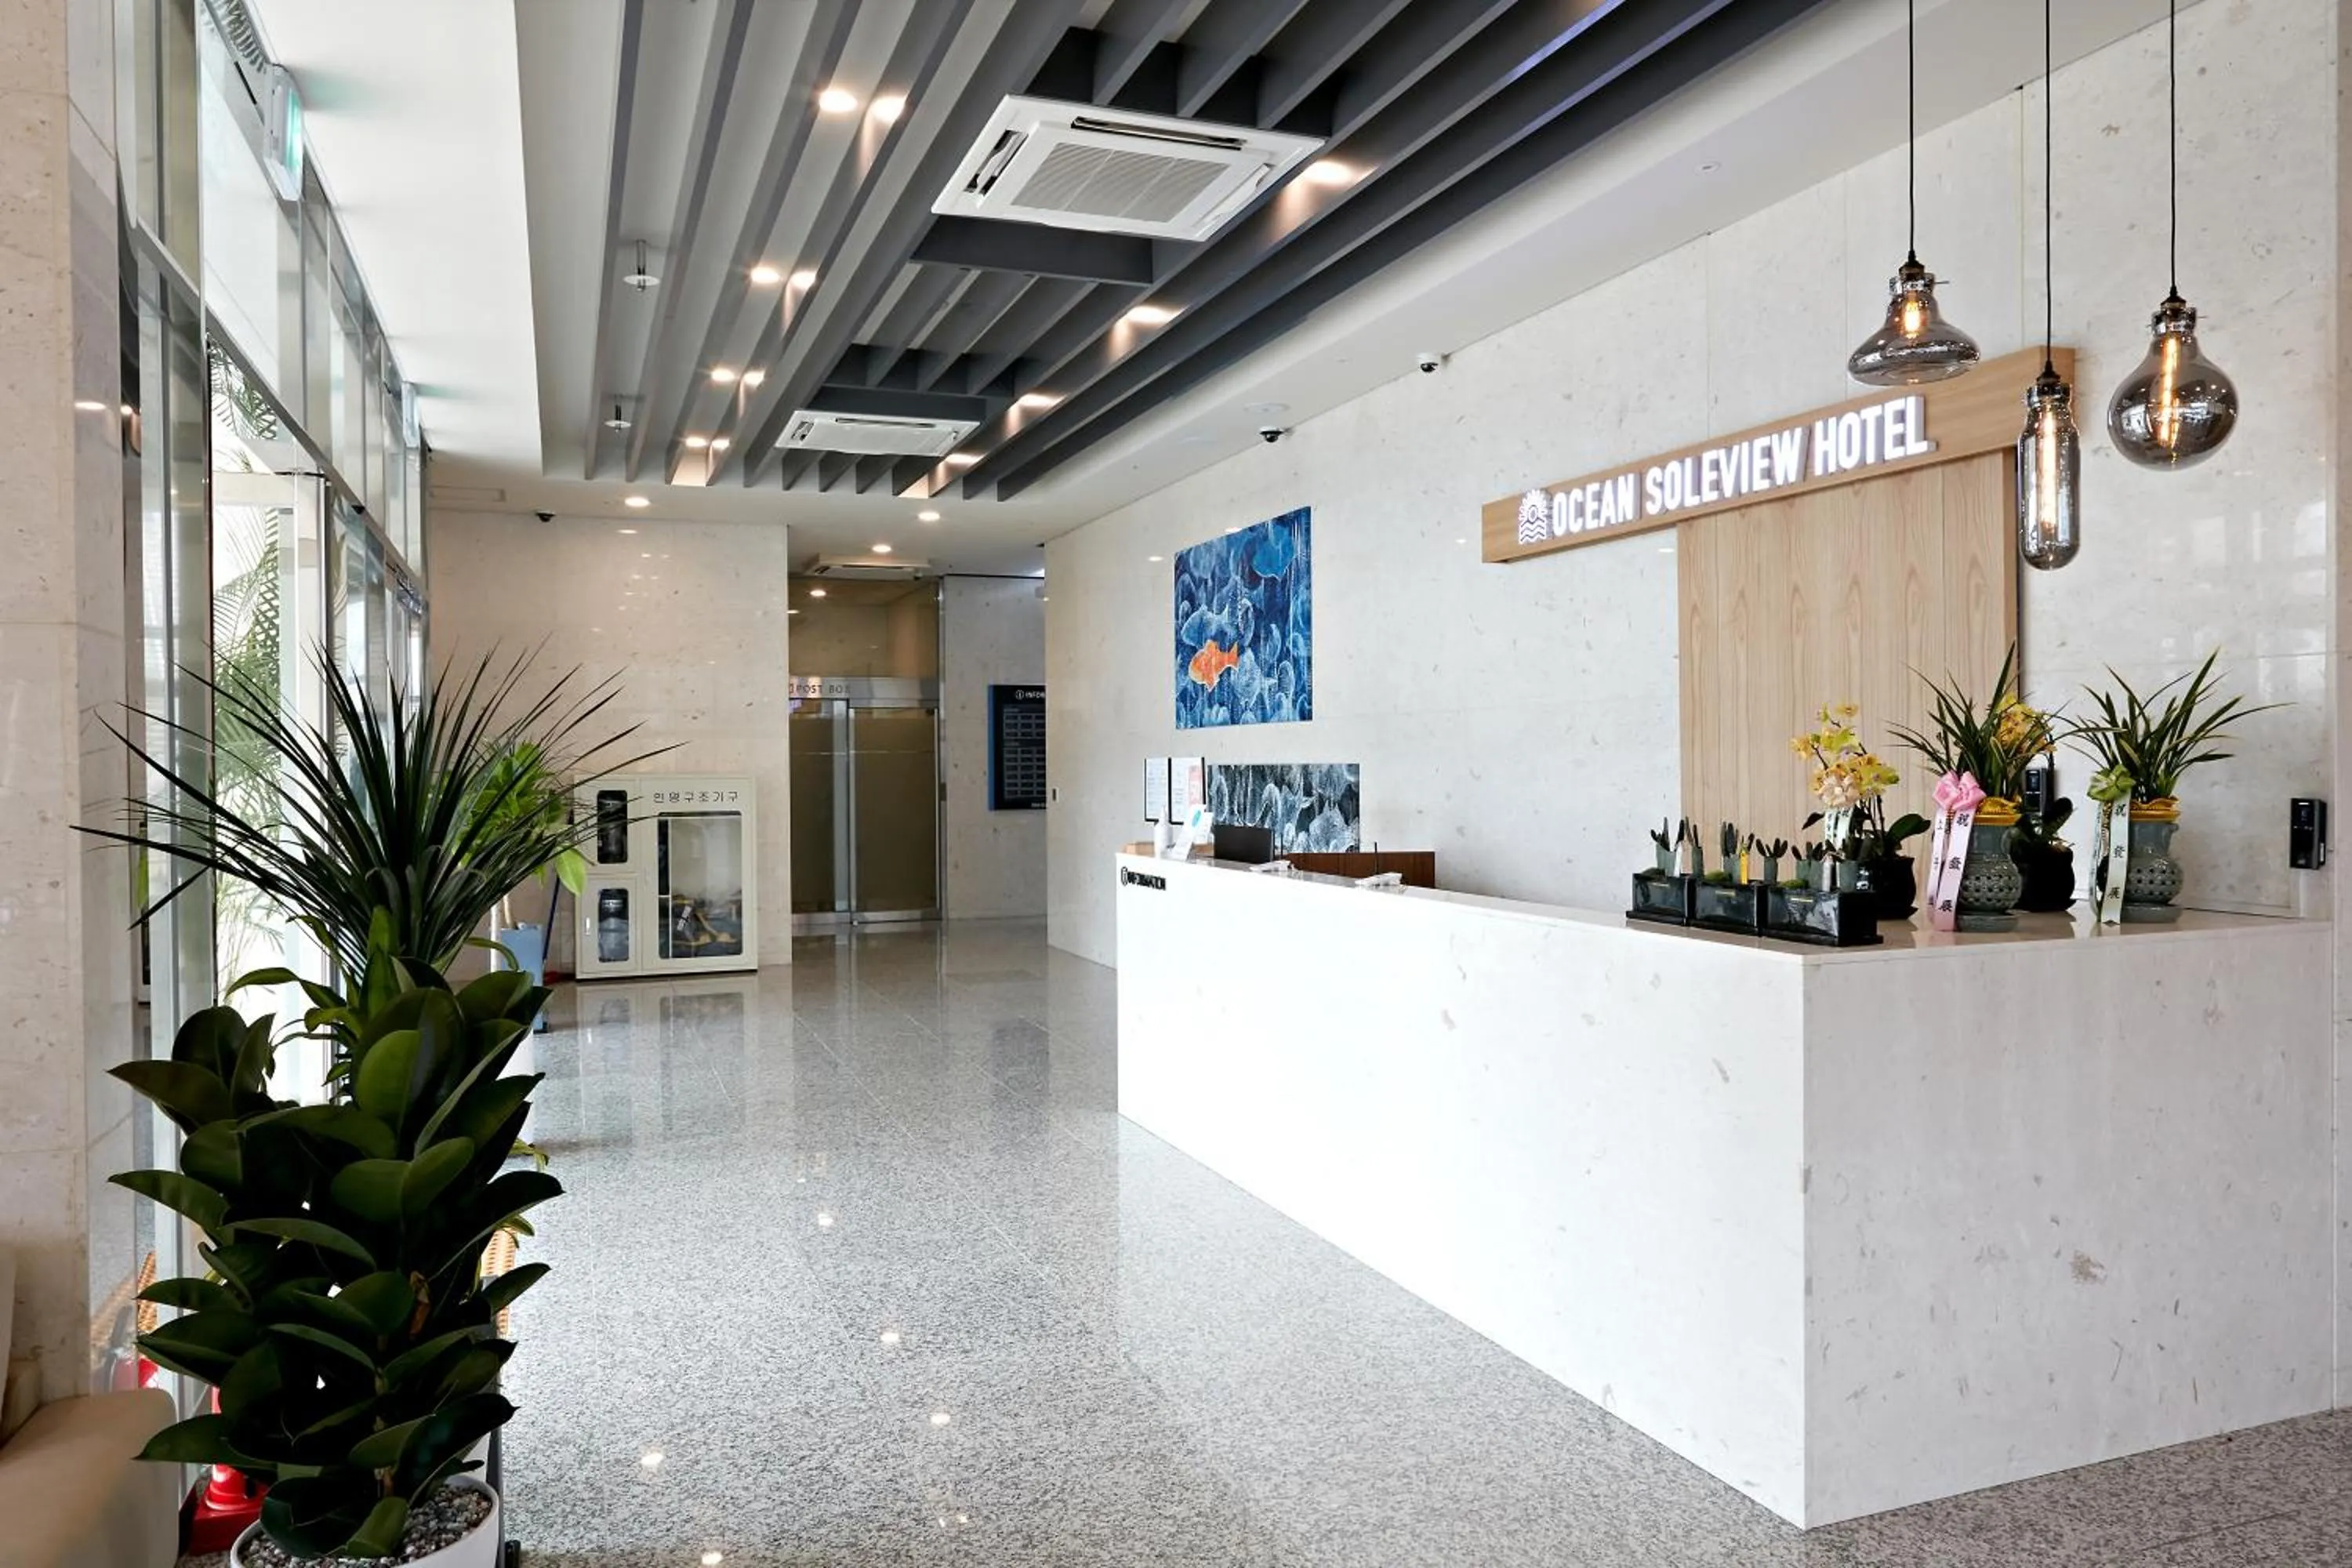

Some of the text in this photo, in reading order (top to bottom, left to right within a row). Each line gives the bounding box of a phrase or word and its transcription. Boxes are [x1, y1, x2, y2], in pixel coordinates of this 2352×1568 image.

[1552, 395, 1930, 537] OCEAN SOLEVIEW HOTEL
[796, 683, 822, 695] POST
